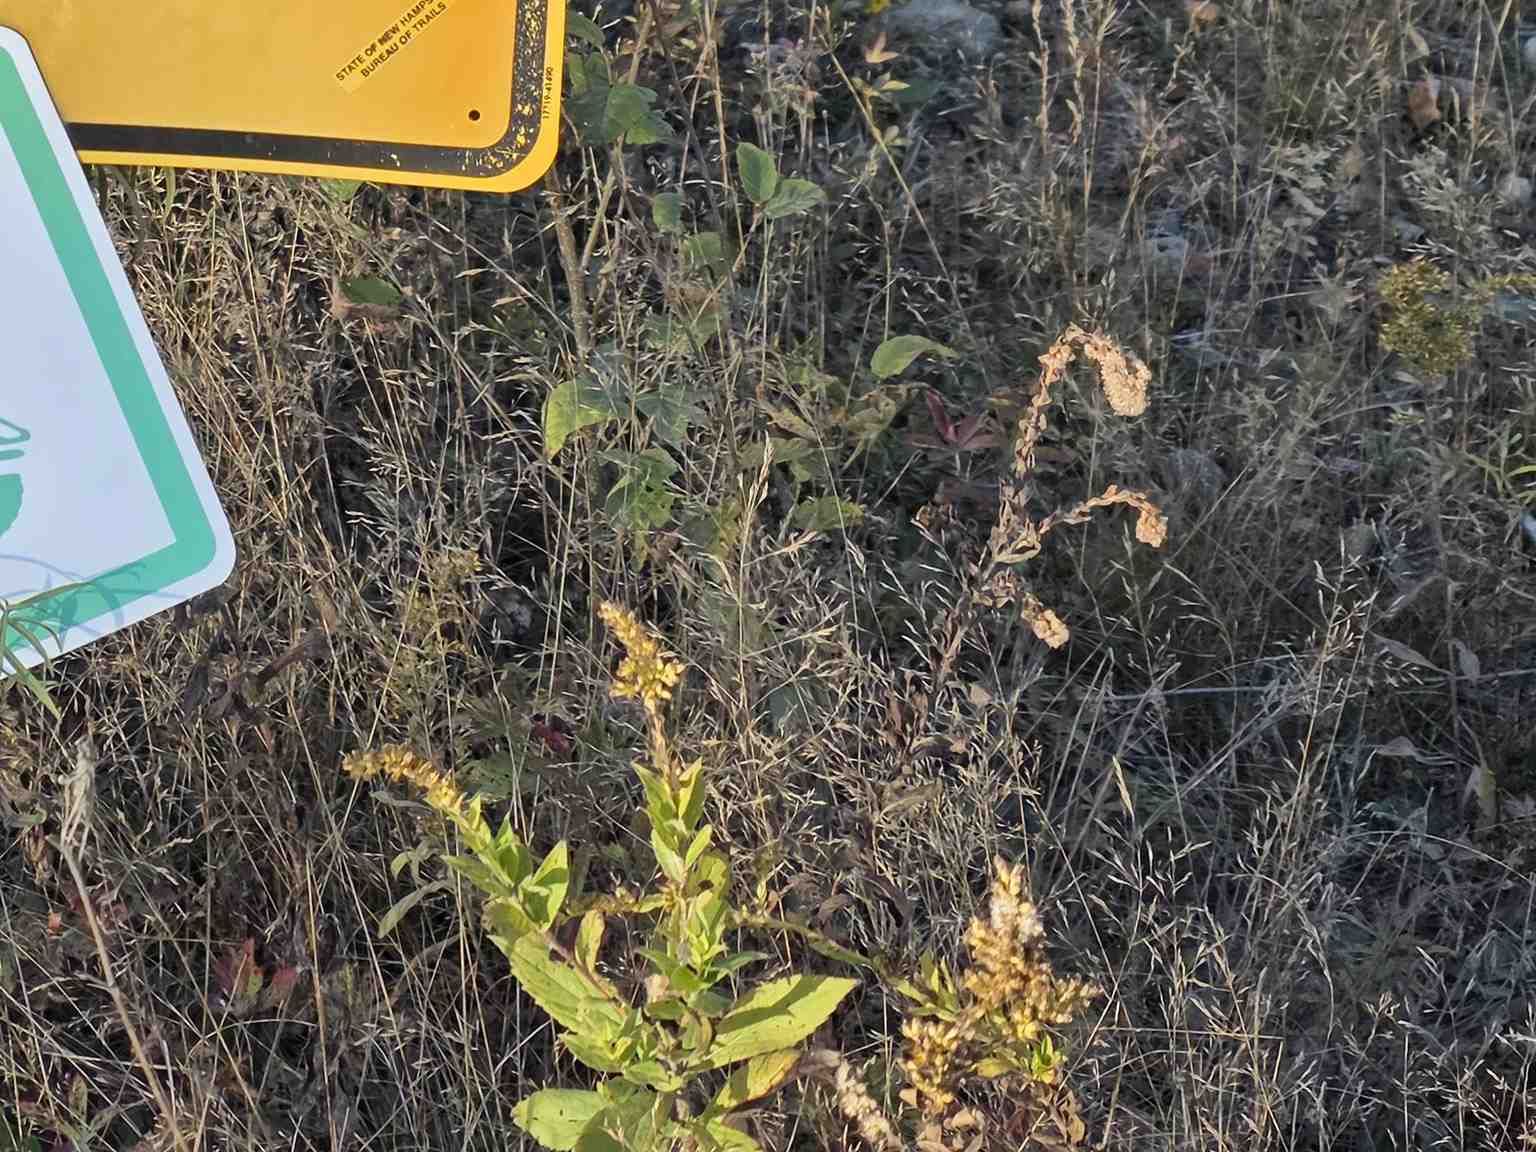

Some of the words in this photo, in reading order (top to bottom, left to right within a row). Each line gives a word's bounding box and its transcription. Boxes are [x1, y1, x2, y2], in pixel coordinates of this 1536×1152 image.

[335, 54, 365, 80] STATE
[364, 43, 378, 57] OF
[377, 23, 401, 46] NEW
[360, 43, 400, 78] BUREAU
[399, 29, 413, 45] OF
[412, 1, 447, 32] TRAILS
